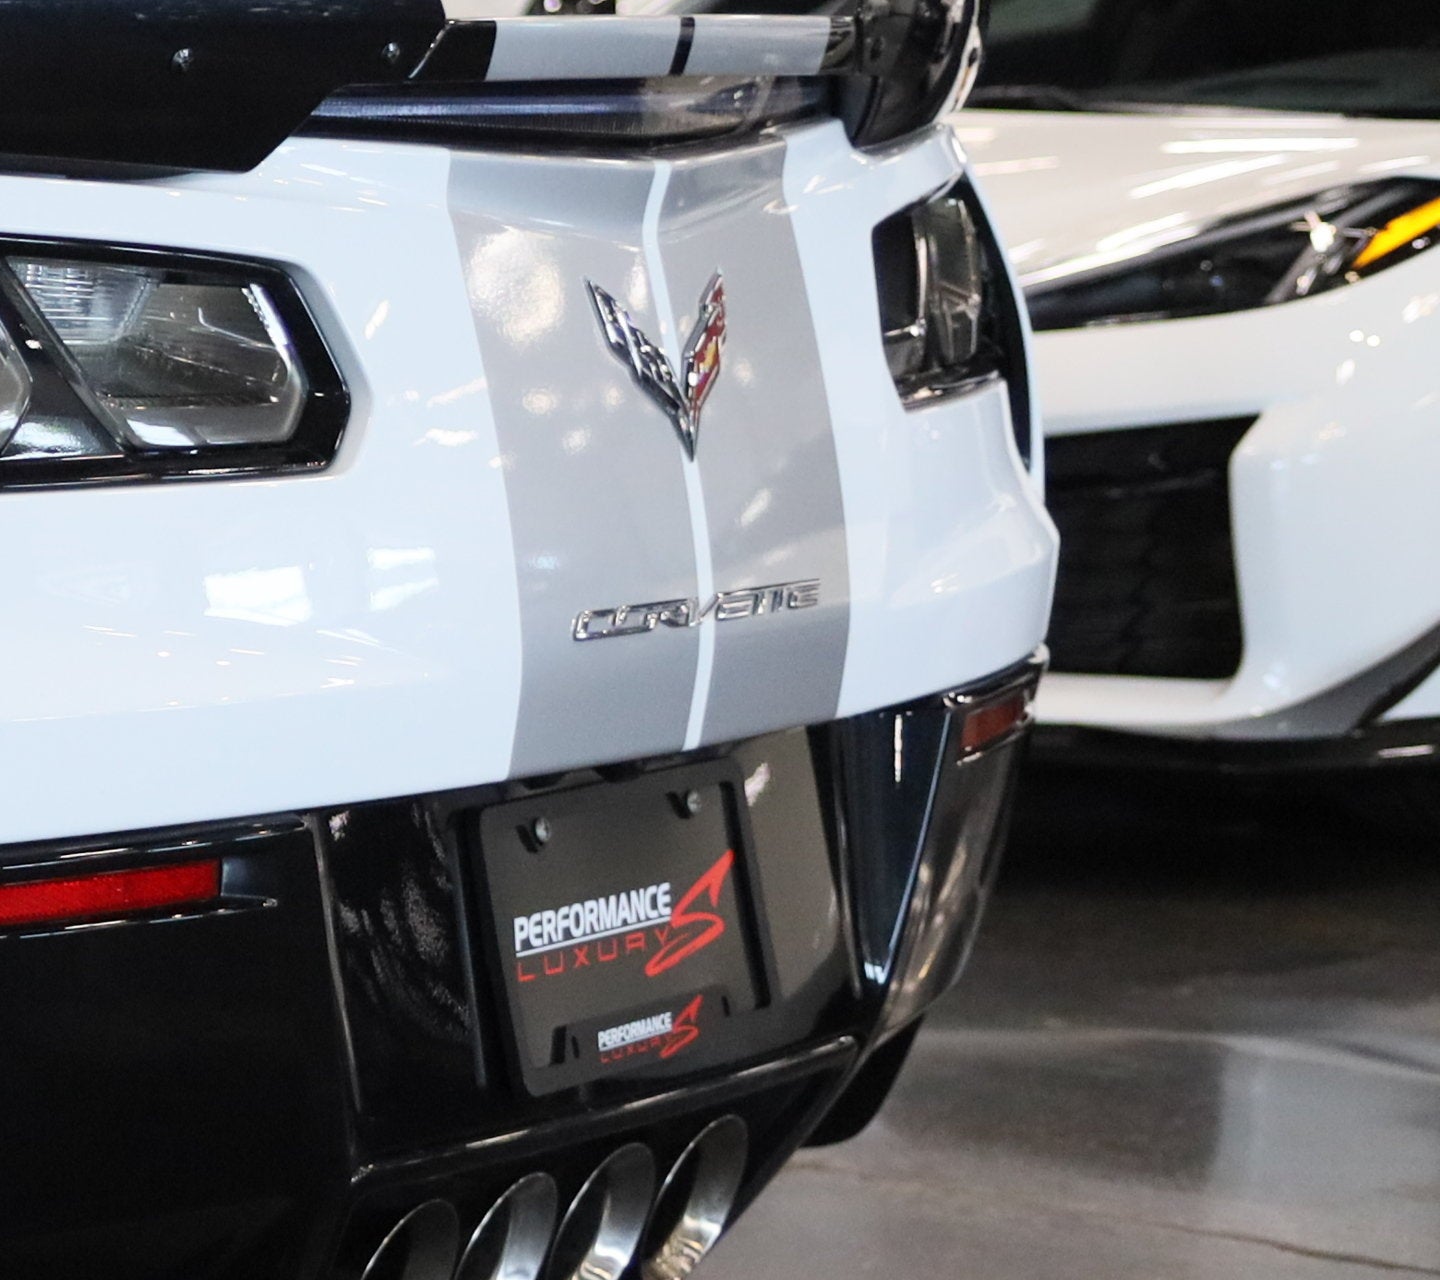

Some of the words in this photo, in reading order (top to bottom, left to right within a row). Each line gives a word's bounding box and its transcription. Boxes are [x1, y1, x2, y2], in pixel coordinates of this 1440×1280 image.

[572, 578, 820, 641] CORVETTE
[514, 882, 672, 951] PERFORMANCE
[517, 926, 672, 982] LUXURY
[598, 1012, 672, 1047] PERFORMANCE
